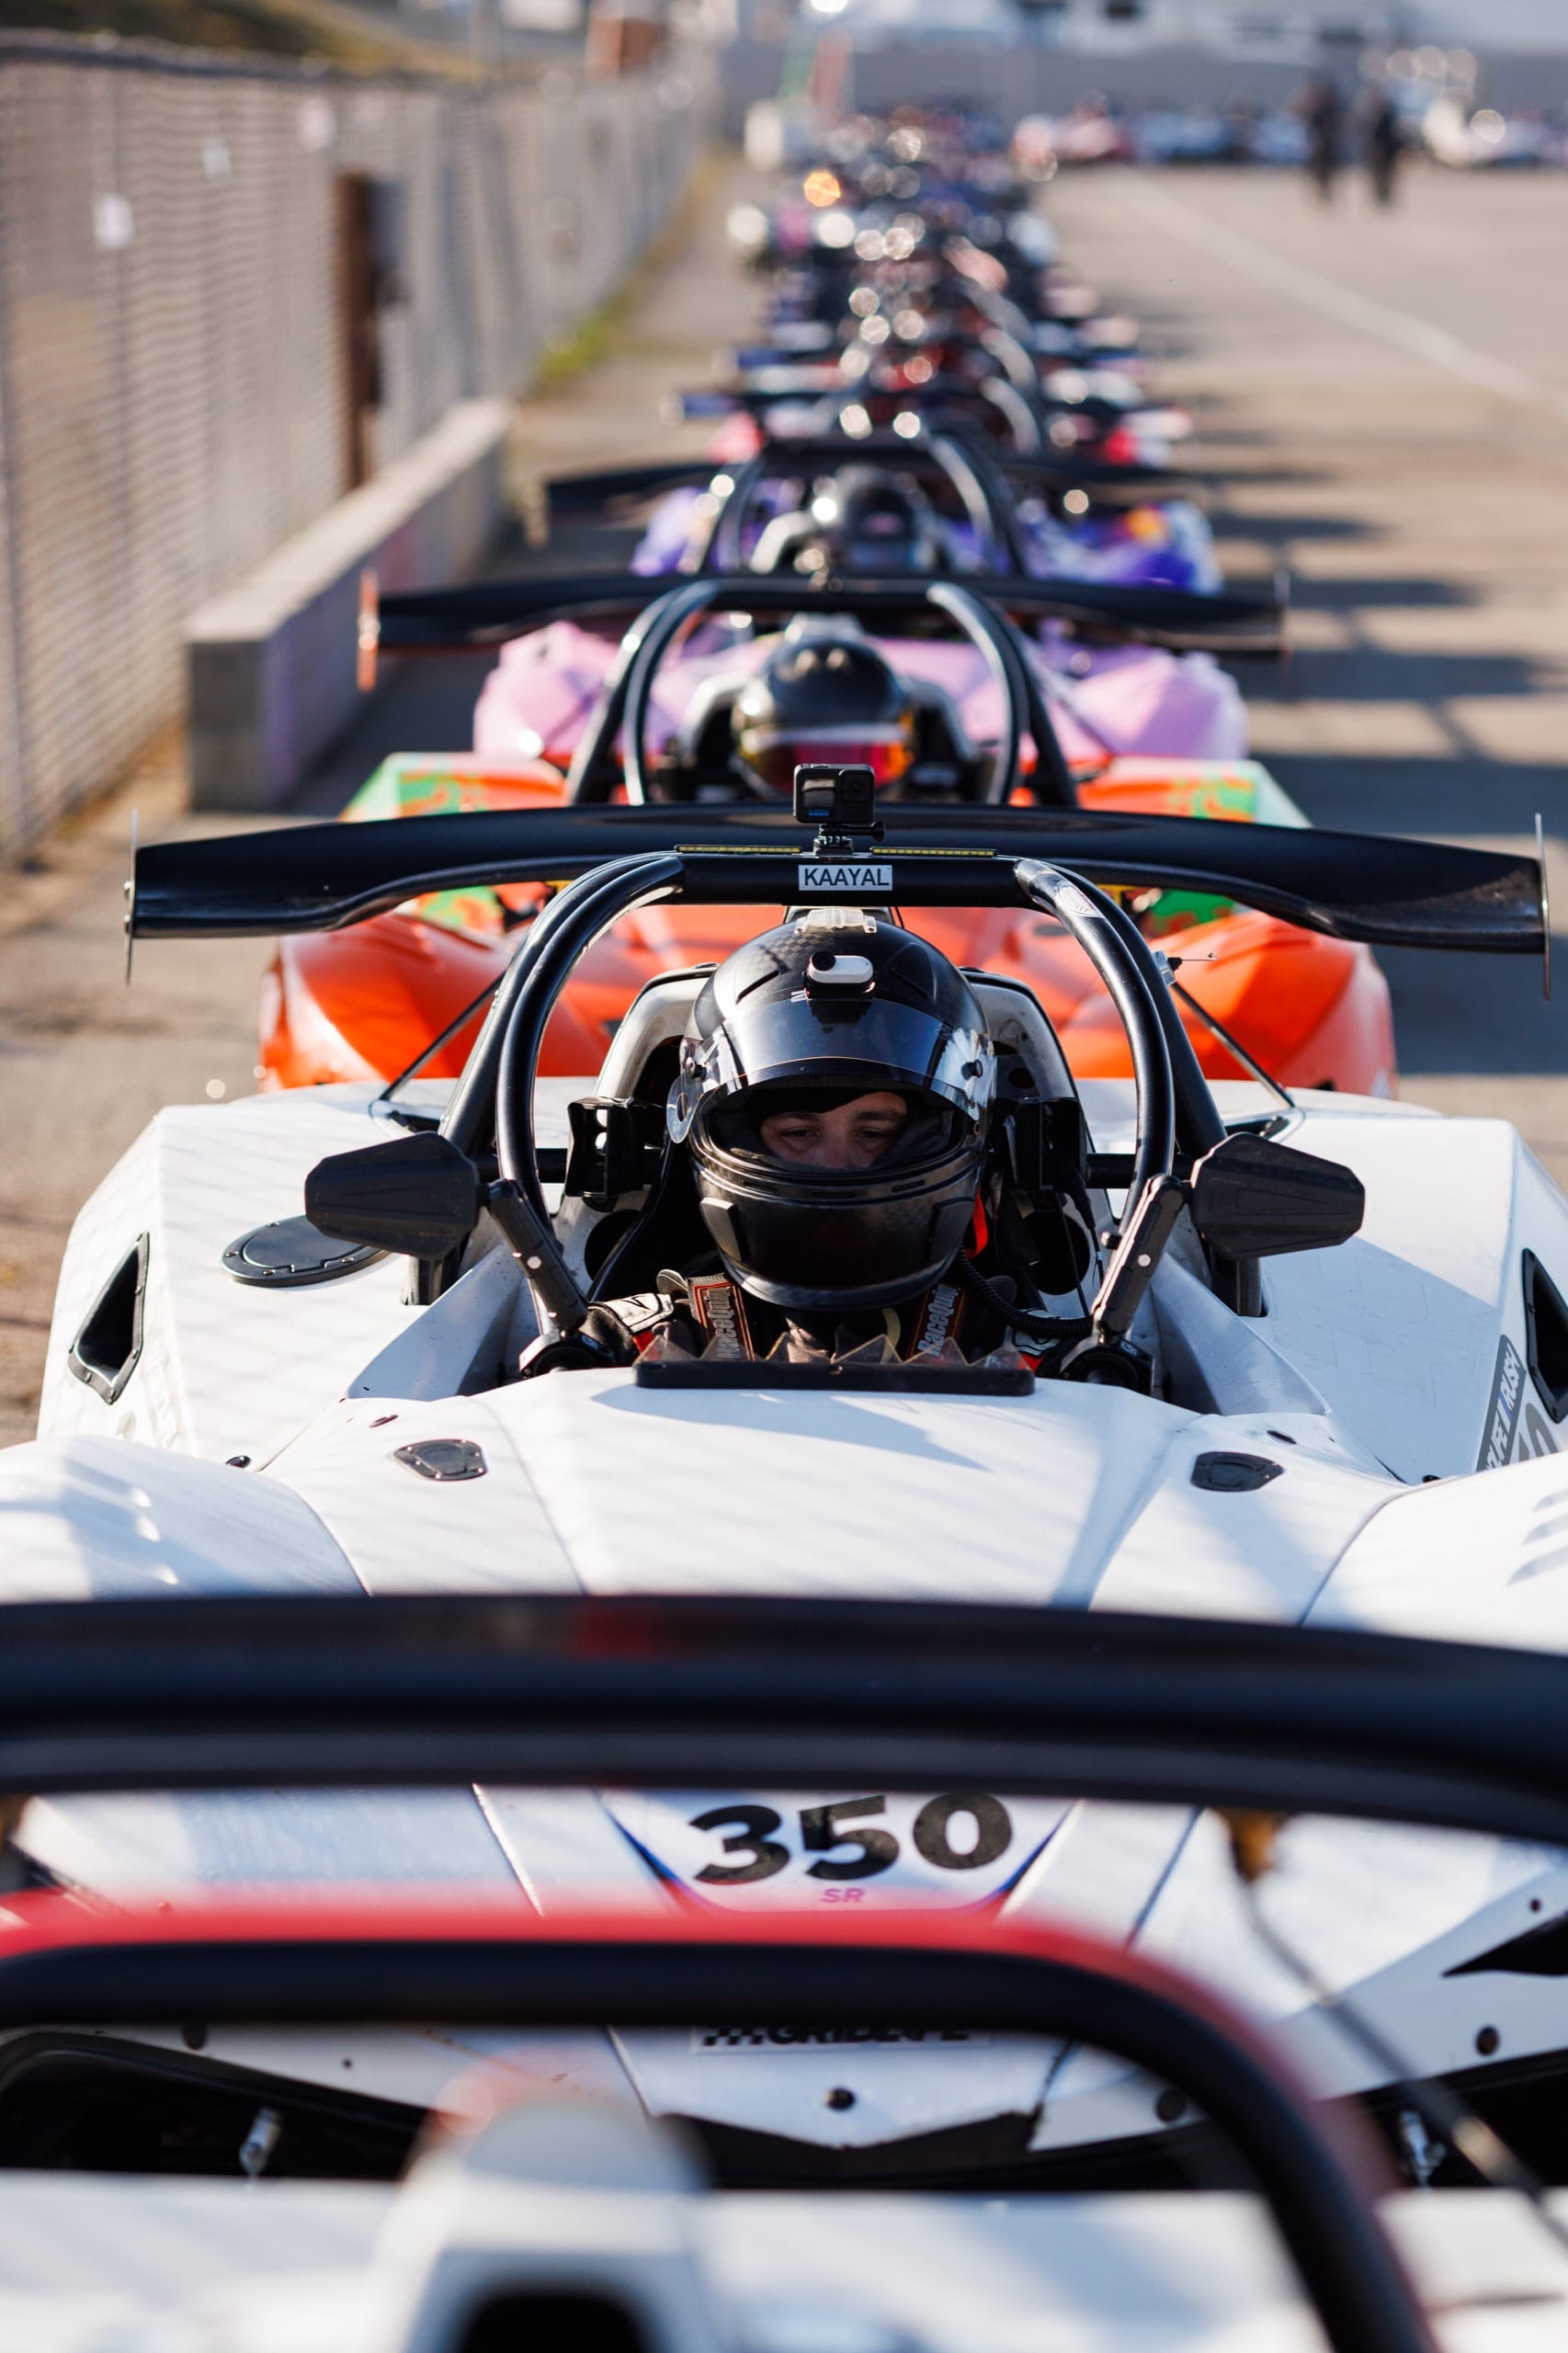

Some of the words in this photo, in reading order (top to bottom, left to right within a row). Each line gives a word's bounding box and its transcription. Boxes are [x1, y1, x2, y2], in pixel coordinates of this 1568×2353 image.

[804, 868, 890, 886] KAAYAL
[917, 1284, 959, 1357] RaceQuip
[1500, 1342, 1521, 1411] RUSH
[688, 1792, 1012, 1885] 350
[821, 1887, 865, 1904] SR
